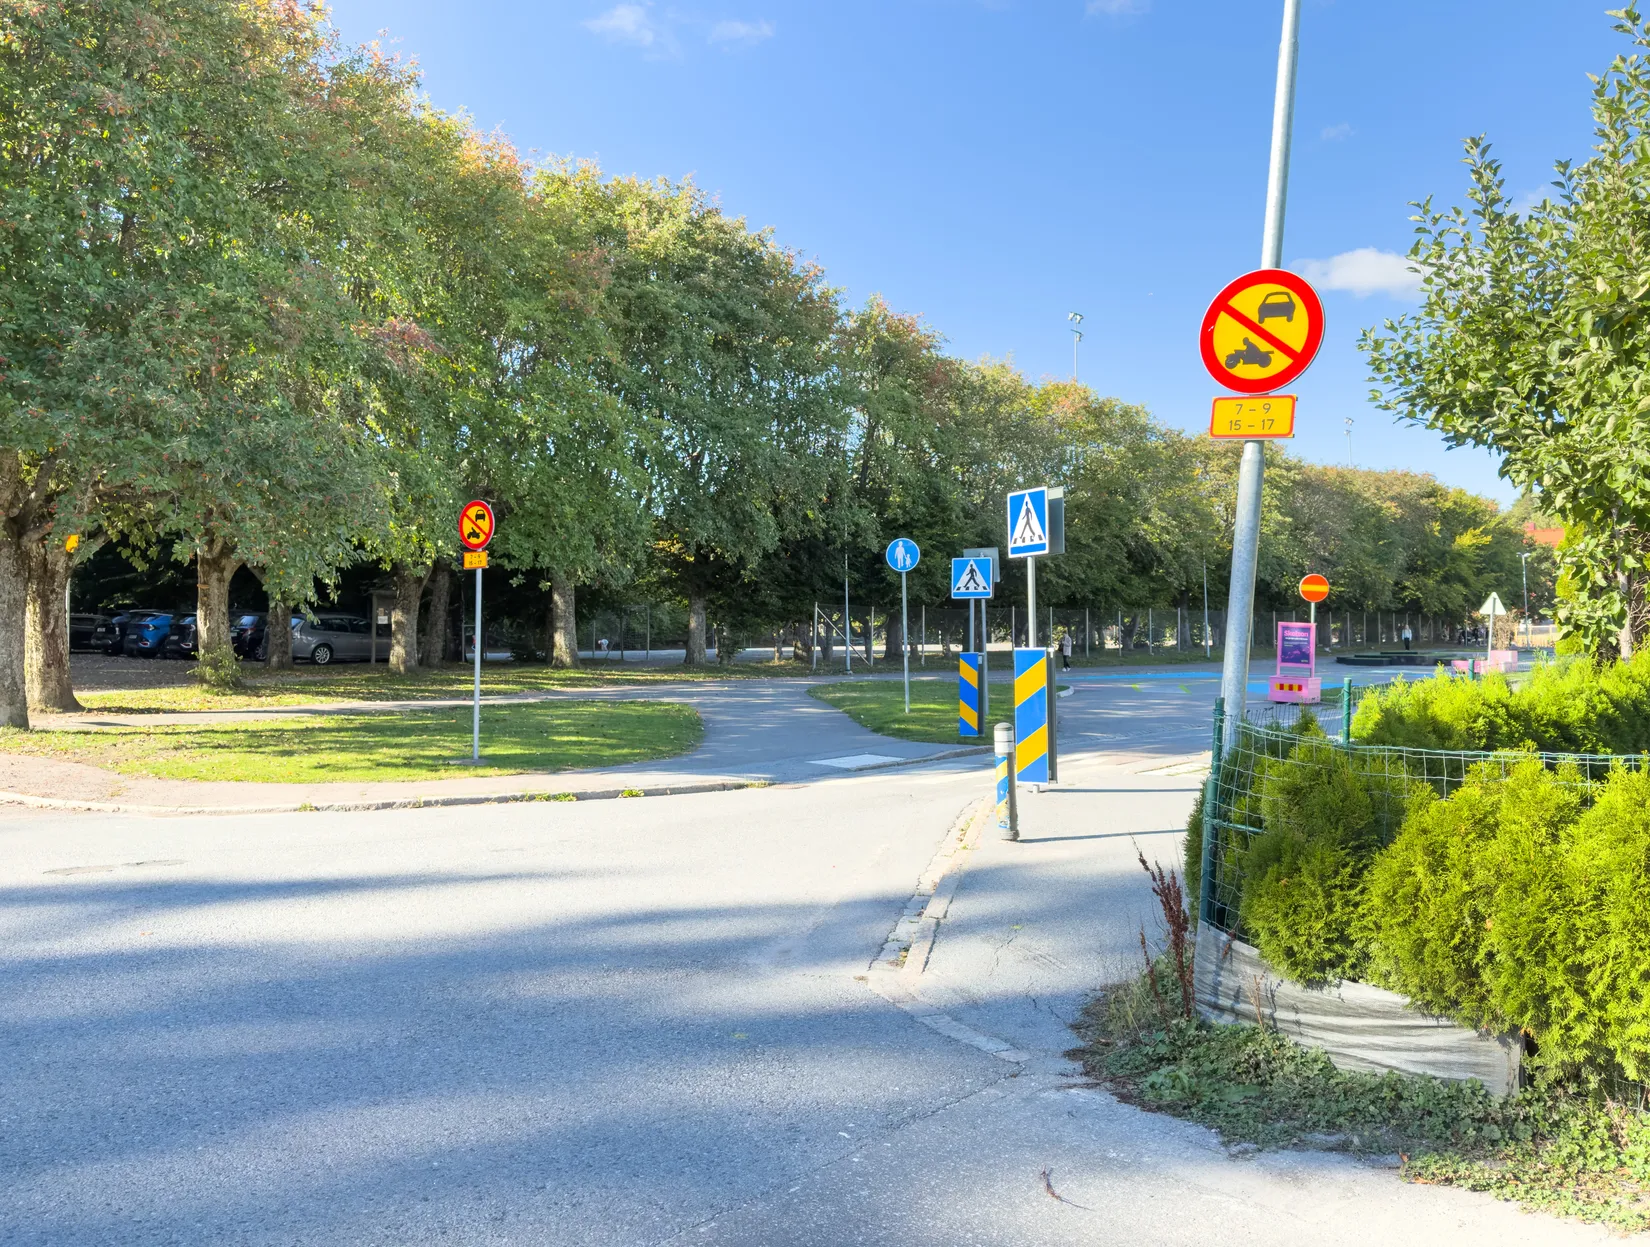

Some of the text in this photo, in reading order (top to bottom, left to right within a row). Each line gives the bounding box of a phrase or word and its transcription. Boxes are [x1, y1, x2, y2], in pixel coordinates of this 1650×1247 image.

[1235, 403, 1243, 415] 7
[1262, 402, 1271, 415] 9
[1229, 419, 1242, 431] 15
[1261, 418, 1275, 430] 17
